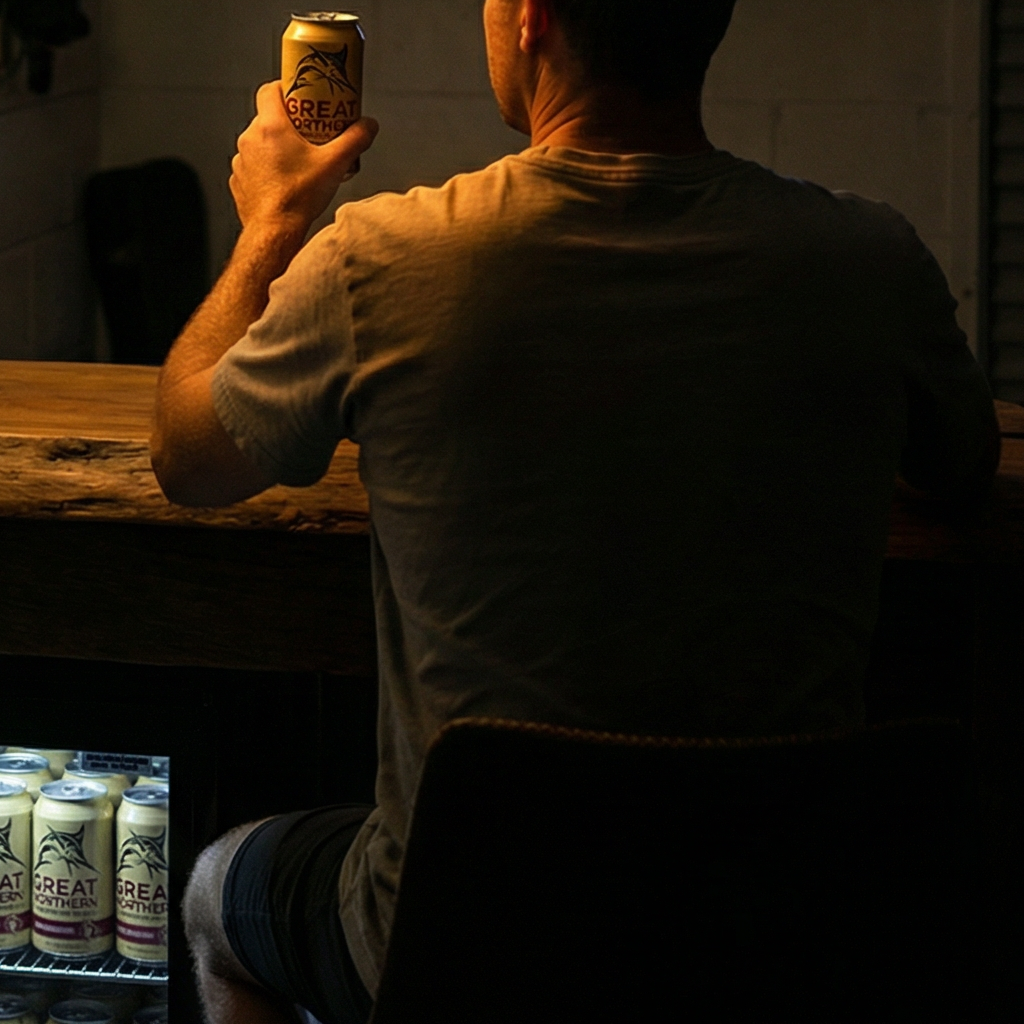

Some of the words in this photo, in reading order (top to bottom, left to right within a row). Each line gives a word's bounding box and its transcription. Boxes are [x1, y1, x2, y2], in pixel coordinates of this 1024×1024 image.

[286, 97, 358, 118] GREAT
[34, 873, 98, 896] GREAT
[116, 878, 167, 901] GREA
